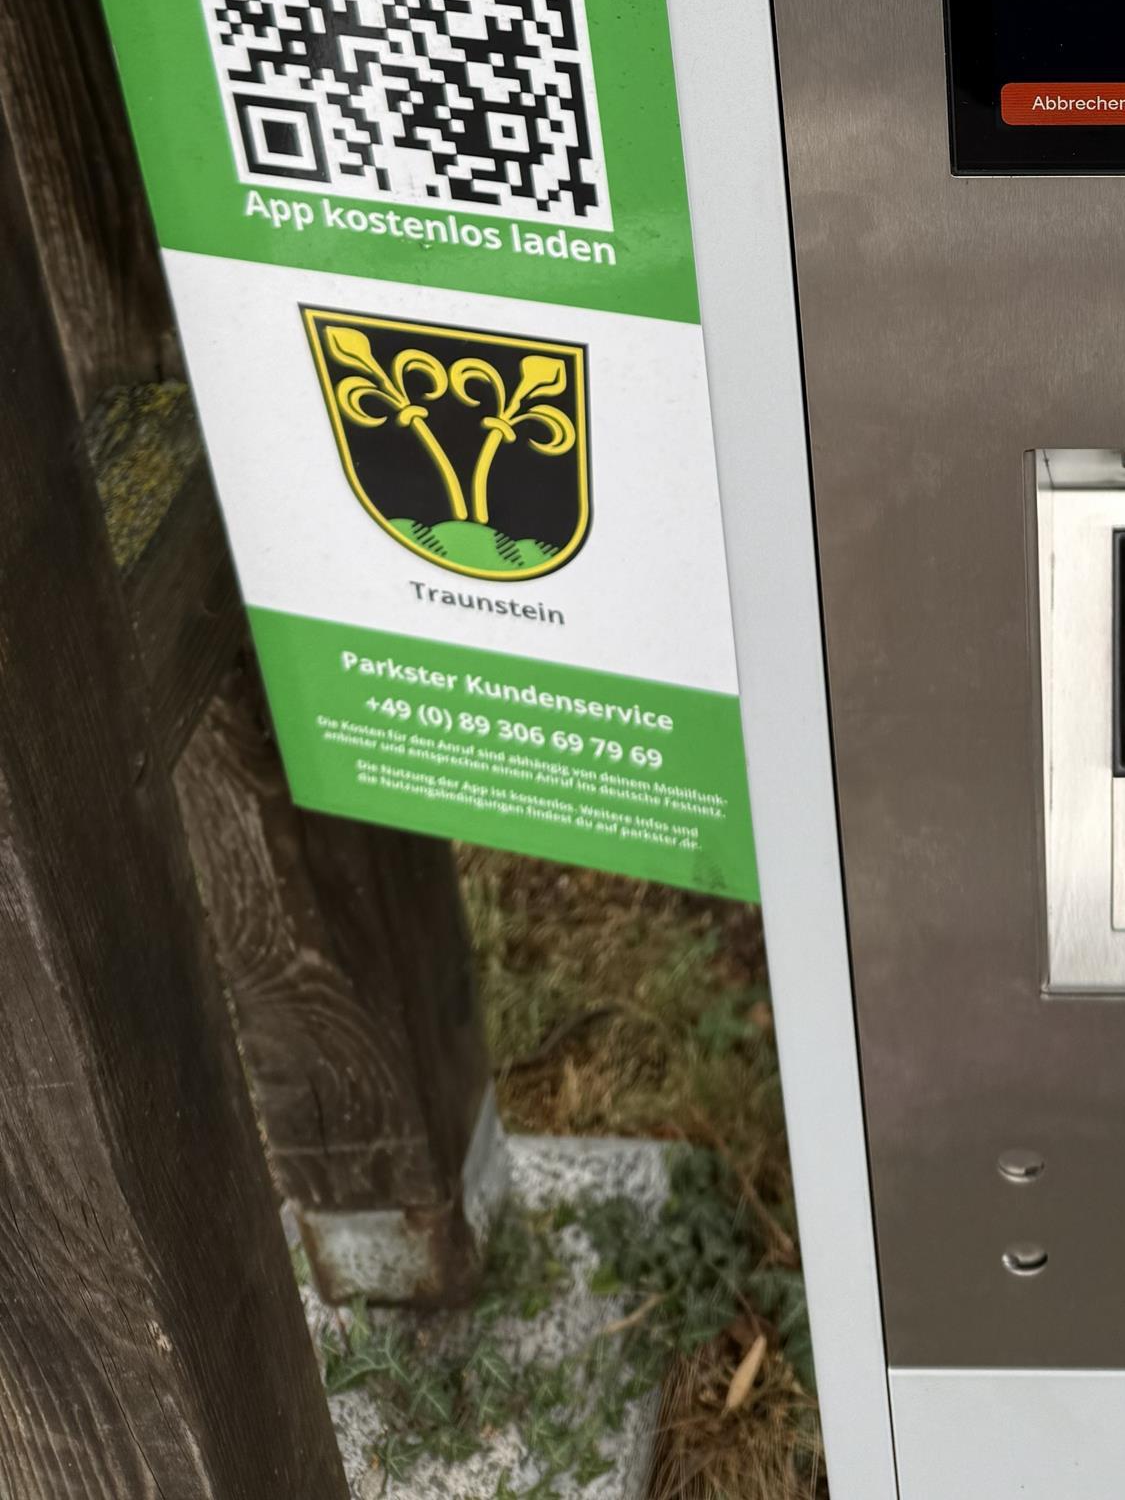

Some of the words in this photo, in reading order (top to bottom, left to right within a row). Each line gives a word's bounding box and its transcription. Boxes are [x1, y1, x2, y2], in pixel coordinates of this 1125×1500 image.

[245, 190, 314, 230] App
[322, 198, 502, 250] kostenlos
[512, 224, 616, 265] laden
[409, 580, 564, 626] Traunstein
[340, 650, 458, 690] Parkster
[465, 674, 674, 732] Kundenservice
[365, 697, 411, 720] +49
[418, 703, 453, 732] (0)
[459, 712, 490, 735] 89
[497, 719, 545, 745] 306
[552, 729, 584, 754] 69
[591, 736, 623, 762] 79
[630, 744, 663, 768] 69
